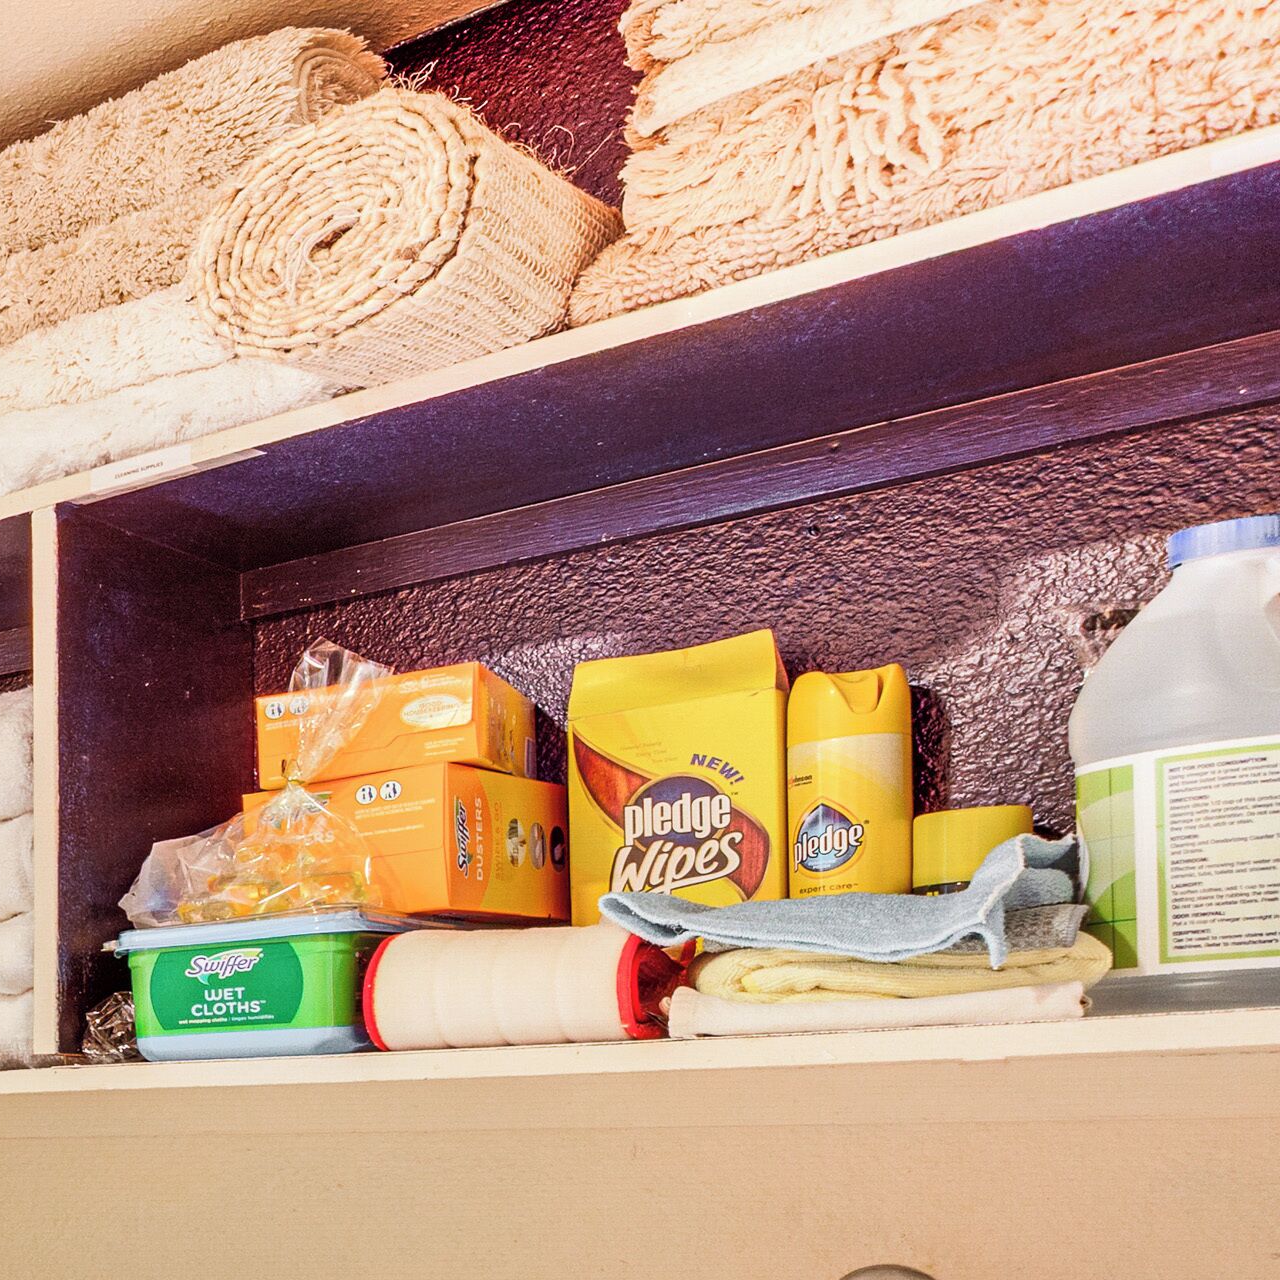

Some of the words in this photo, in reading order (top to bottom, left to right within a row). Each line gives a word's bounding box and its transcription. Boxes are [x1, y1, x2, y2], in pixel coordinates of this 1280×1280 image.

[690, 753, 745, 785] NEW!
[456, 800, 470, 880] Swiffer
[474, 796, 483, 881] DUSTERS
[623, 792, 733, 847] pledge
[610, 832, 744, 895] Wipes
[793, 823, 864, 873] pledge
[799, 885, 826, 894] expert
[185, 954, 260, 980] Swiffer
[204, 987, 245, 1001] WET
